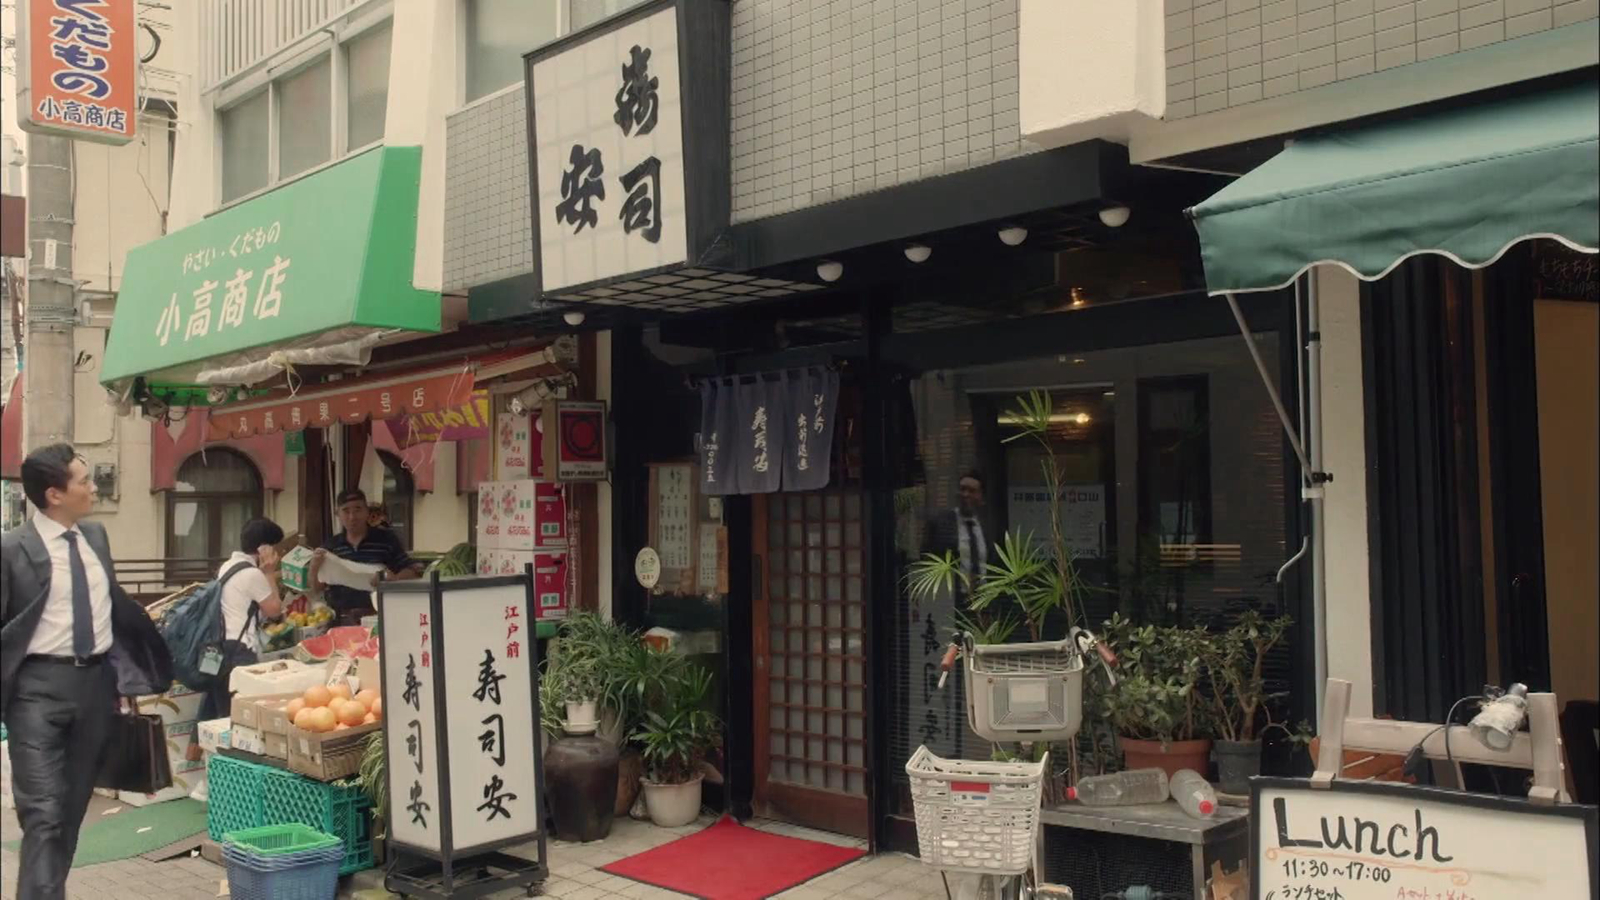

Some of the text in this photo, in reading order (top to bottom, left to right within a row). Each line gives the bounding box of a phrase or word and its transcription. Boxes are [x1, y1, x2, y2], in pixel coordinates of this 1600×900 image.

[38, 97, 126, 132] 小高商店
[555, 144, 605, 235] 安
[182, 221, 281, 275] やさい・くだもの
[156, 255, 291, 347] 小高商店
[419, 612, 431, 668] 江戸前
[504, 605, 520, 659] 江戸前
[402, 653, 431, 829] 寿司安
[473, 649, 517, 821] 寿司安
[1273, 797, 1454, 863] Lunch
